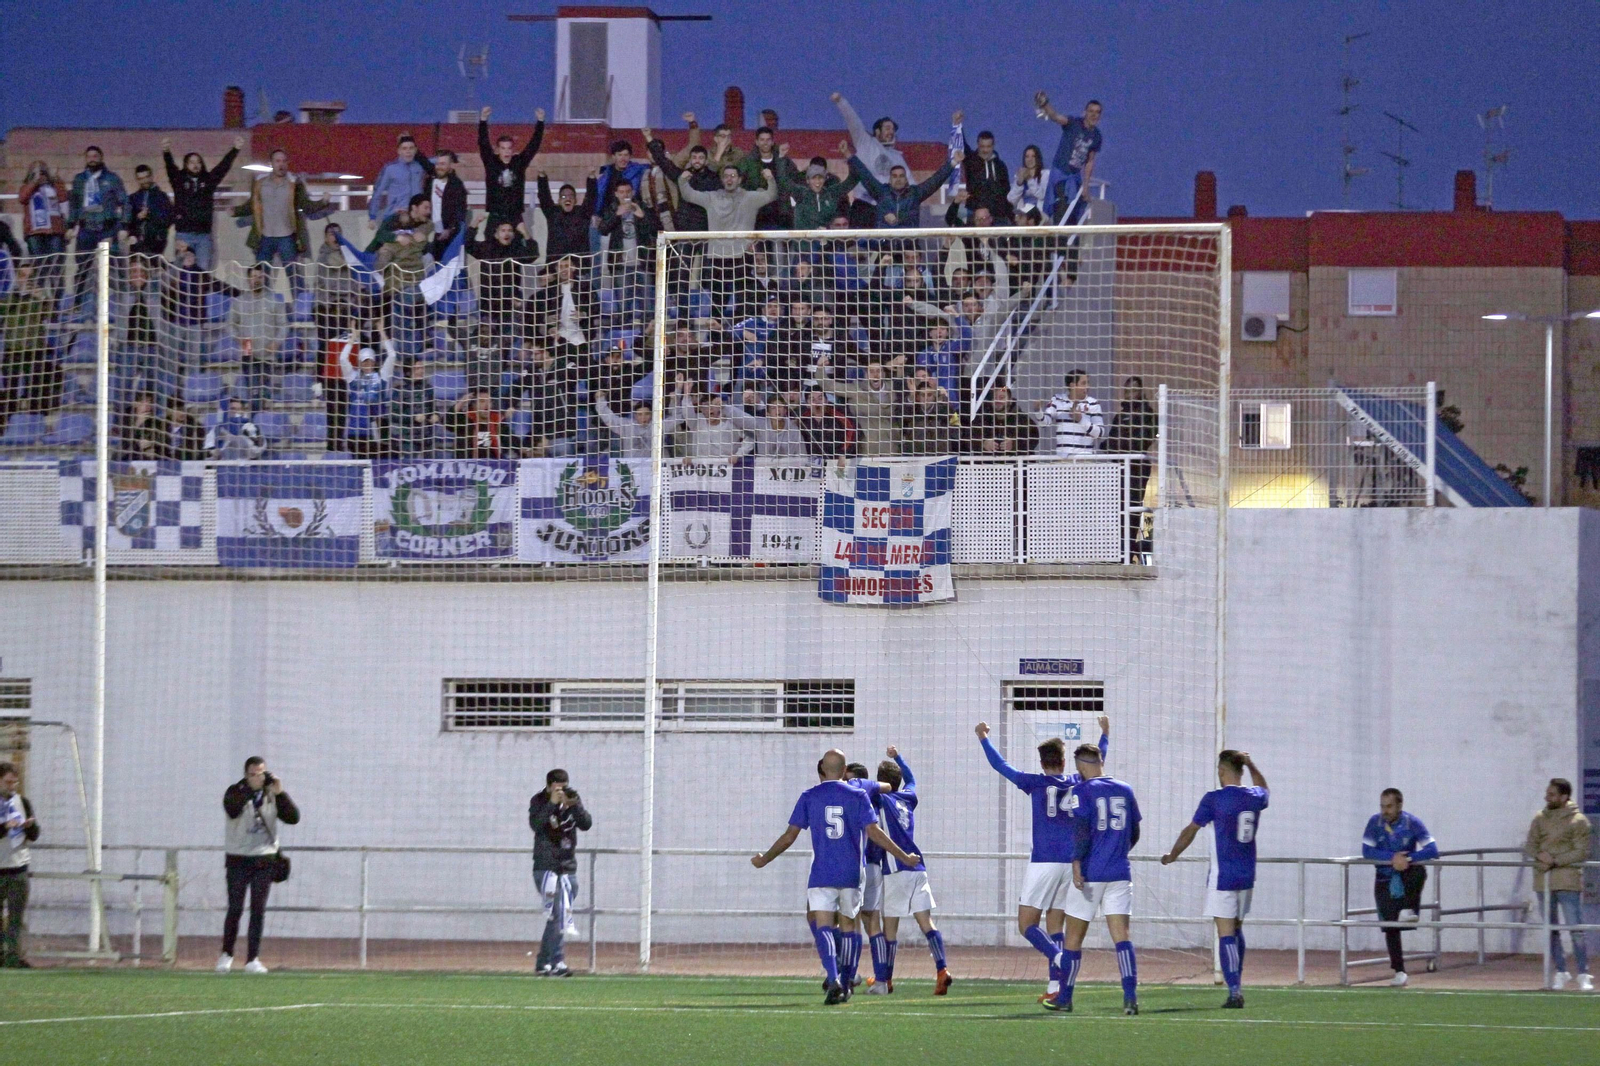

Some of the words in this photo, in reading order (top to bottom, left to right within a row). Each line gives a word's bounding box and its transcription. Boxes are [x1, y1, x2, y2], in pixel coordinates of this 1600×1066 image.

[384, 462, 508, 490] KOMANDO
[670, 463, 728, 478] HOOLS
[769, 467, 806, 482] XCD
[563, 481, 635, 511] HOOLS
[395, 530, 491, 556] CORNER
[761, 534, 803, 550] 1947
[1072, 664, 1078, 672] 2
[1046, 785, 1075, 818] 14
[1096, 796, 1127, 831] 15
[825, 805, 845, 840] 5
[1237, 810, 1255, 843] 6
